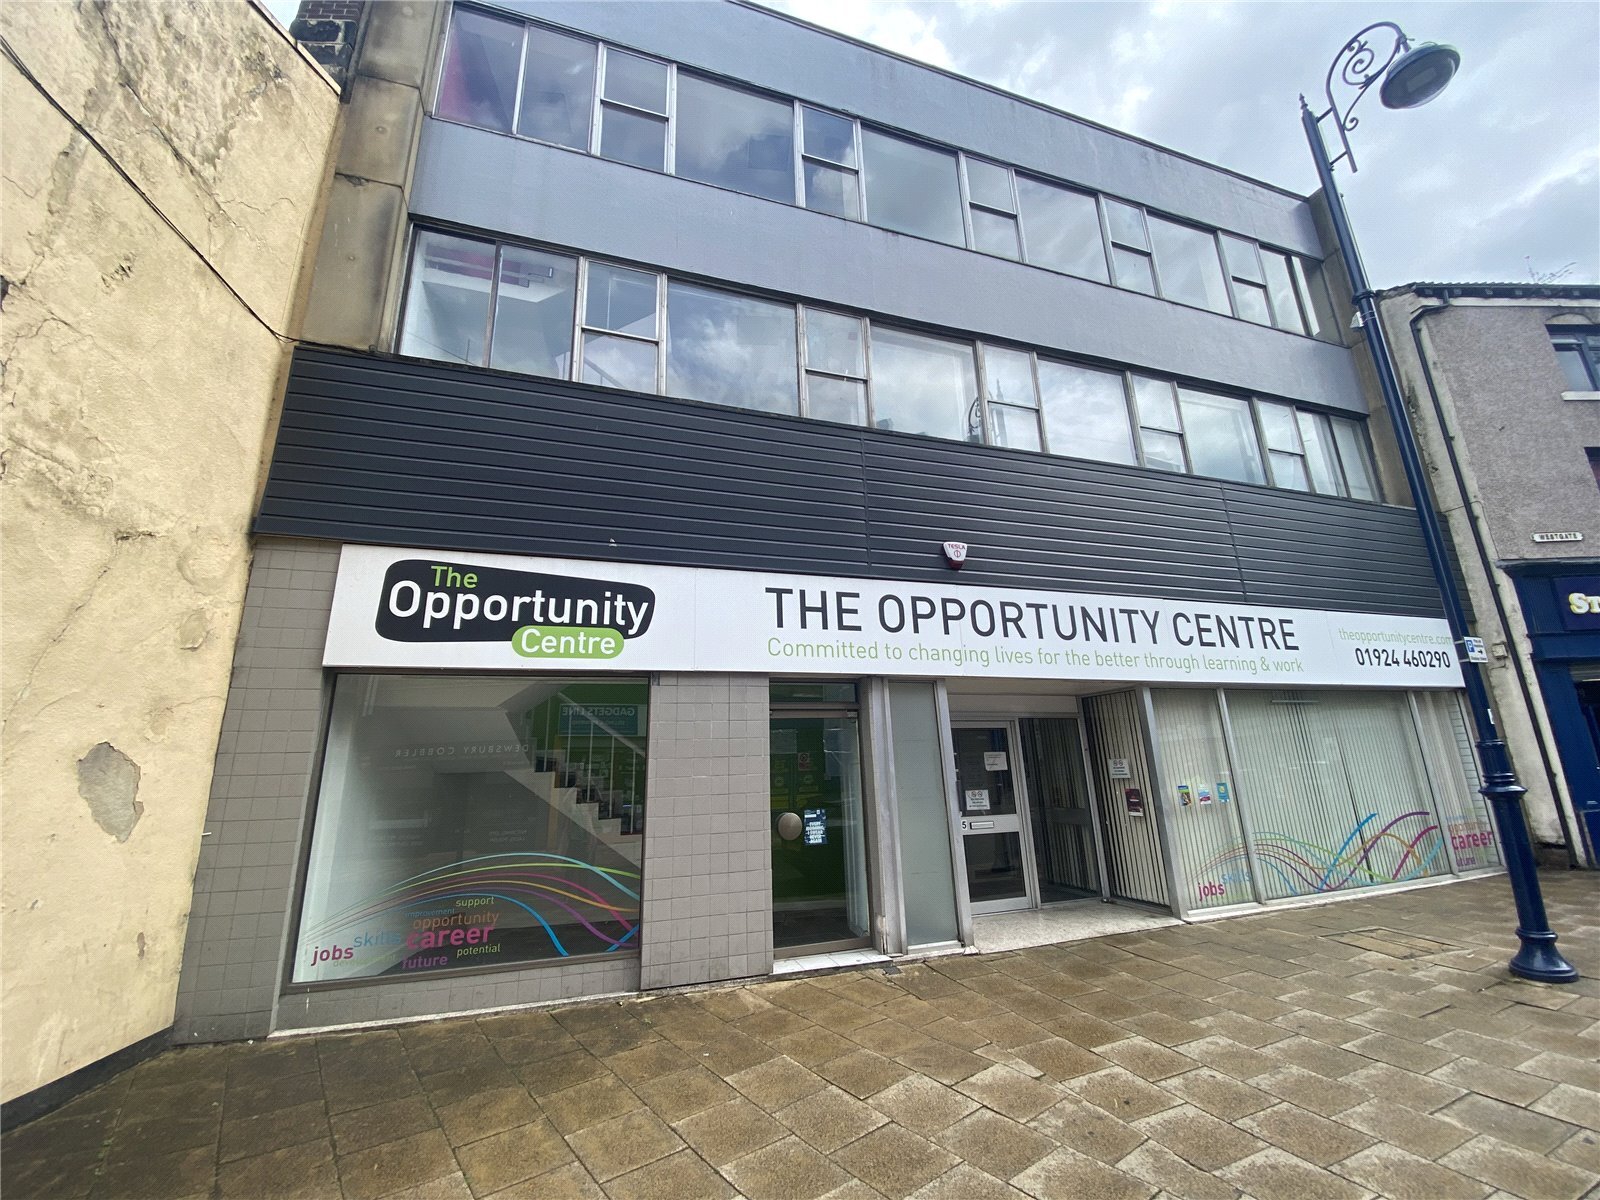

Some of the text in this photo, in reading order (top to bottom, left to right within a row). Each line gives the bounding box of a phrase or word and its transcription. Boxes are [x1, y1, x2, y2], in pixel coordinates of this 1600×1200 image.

[431, 565, 478, 589] The
[388, 580, 649, 635] Opportunity
[765, 587, 1300, 651] THE OPPORTUNITY CENTRE
[521, 628, 616, 655] Centre
[1339, 628, 1452, 645] theopportunitycentre.com
[767, 637, 1304, 675] Committed to changing lives for the better through learning & work
[1355, 648, 1450, 668] 01924 460290
[962, 821, 967, 829] 5
[1451, 831, 1493, 850] career
[1198, 881, 1225, 901] jobs
[456, 896, 495, 909] support
[405, 908, 455, 918] improvement
[413, 911, 499, 931] opportunity
[353, 931, 400, 948] skills
[406, 924, 495, 950] career
[311, 945, 354, 966] jobs
[456, 944, 501, 958] potential
[401, 956, 448, 969] future
